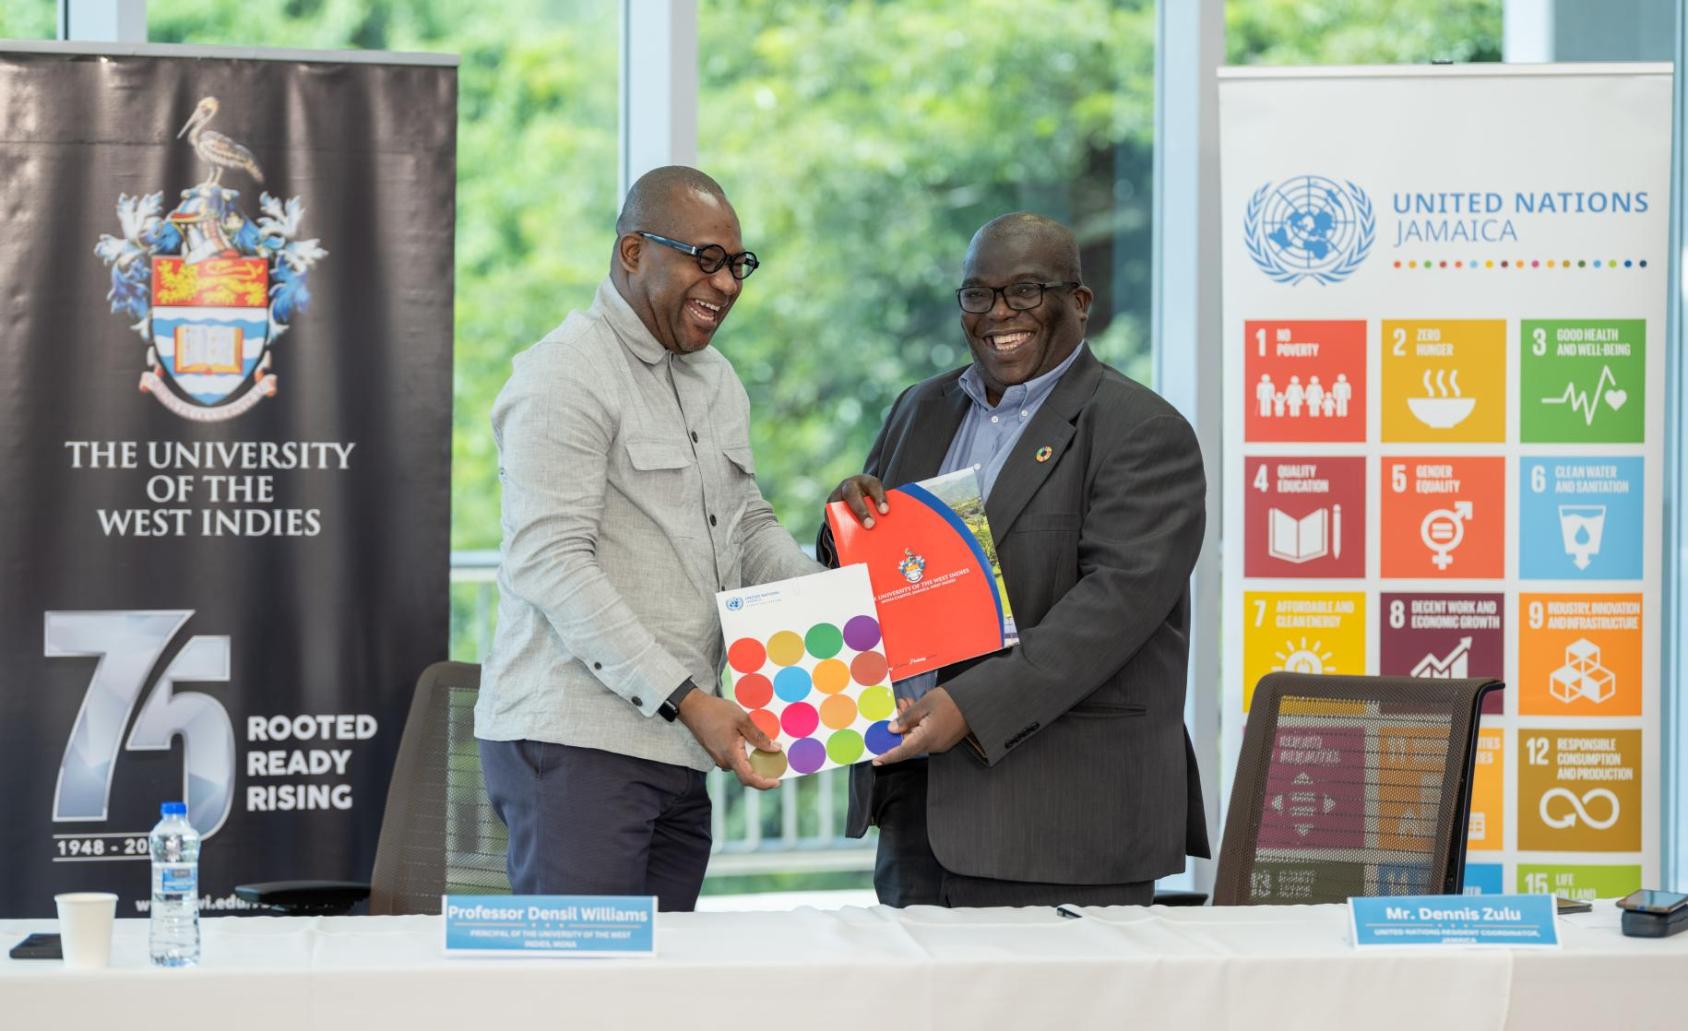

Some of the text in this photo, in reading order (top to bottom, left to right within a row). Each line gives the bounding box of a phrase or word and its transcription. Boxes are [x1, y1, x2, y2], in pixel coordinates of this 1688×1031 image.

[1393, 191, 1649, 214] UNITED NATIONS
[1394, 219, 1518, 247] JAMAICA
[1256, 328, 1266, 356] 1
[1277, 329, 1292, 341] NO
[1393, 328, 1407, 356] 2
[1416, 329, 1441, 341] ZERO
[1532, 328, 1546, 356] 3
[1557, 328, 1618, 341] GOOD HEALTH
[1277, 343, 1319, 357] POVERTY
[1416, 343, 1454, 356] HUNGER
[1557, 343, 1631, 356] AND WELL-BEING
[65, 441, 355, 469] THE UNIVERSITY
[1254, 464, 1269, 492] 4
[1277, 465, 1316, 478] QUALITY
[1392, 464, 1407, 492] 5
[1416, 465, 1453, 478] GENDER
[1531, 465, 1546, 493] 6
[1555, 465, 1617, 478] CLEAN WATER
[146, 475, 274, 503] OF THE
[1277, 480, 1329, 493] EDUCATION
[1416, 480, 1460, 493] EQUALITY
[1555, 480, 1630, 493] AND SANITATION
[97, 509, 321, 536] WEST INDIES
[878, 585, 911, 600] UNIVERSITY
[933, 575, 949, 584] WEST
[1253, 600, 1266, 628] 7
[1390, 601, 1405, 629] 8
[1411, 601, 1497, 614] DECENT WORK AND
[1529, 602, 1544, 629] 9
[1411, 616, 1500, 629] ECONOMIC GROWTH
[44, 609, 236, 841] 75
[247, 715, 378, 741] ROOTED
[1527, 737, 1549, 765] 12
[1557, 738, 1616, 750] RESPONSIBLE
[247, 749, 352, 776] READY
[1557, 753, 1621, 765] CONSUMPTION
[1557, 768, 1633, 780] AND PRODUCTION
[247, 784, 352, 810] RISING
[57, 839, 105, 856] 1948
[124, 838, 149, 854] 20
[1525, 873, 1549, 895] 15
[1556, 874, 1574, 885] LIFE
[448, 905, 648, 922] Professor Densil Williams
[1386, 907, 1521, 921] Mr. Dennis Zulu
